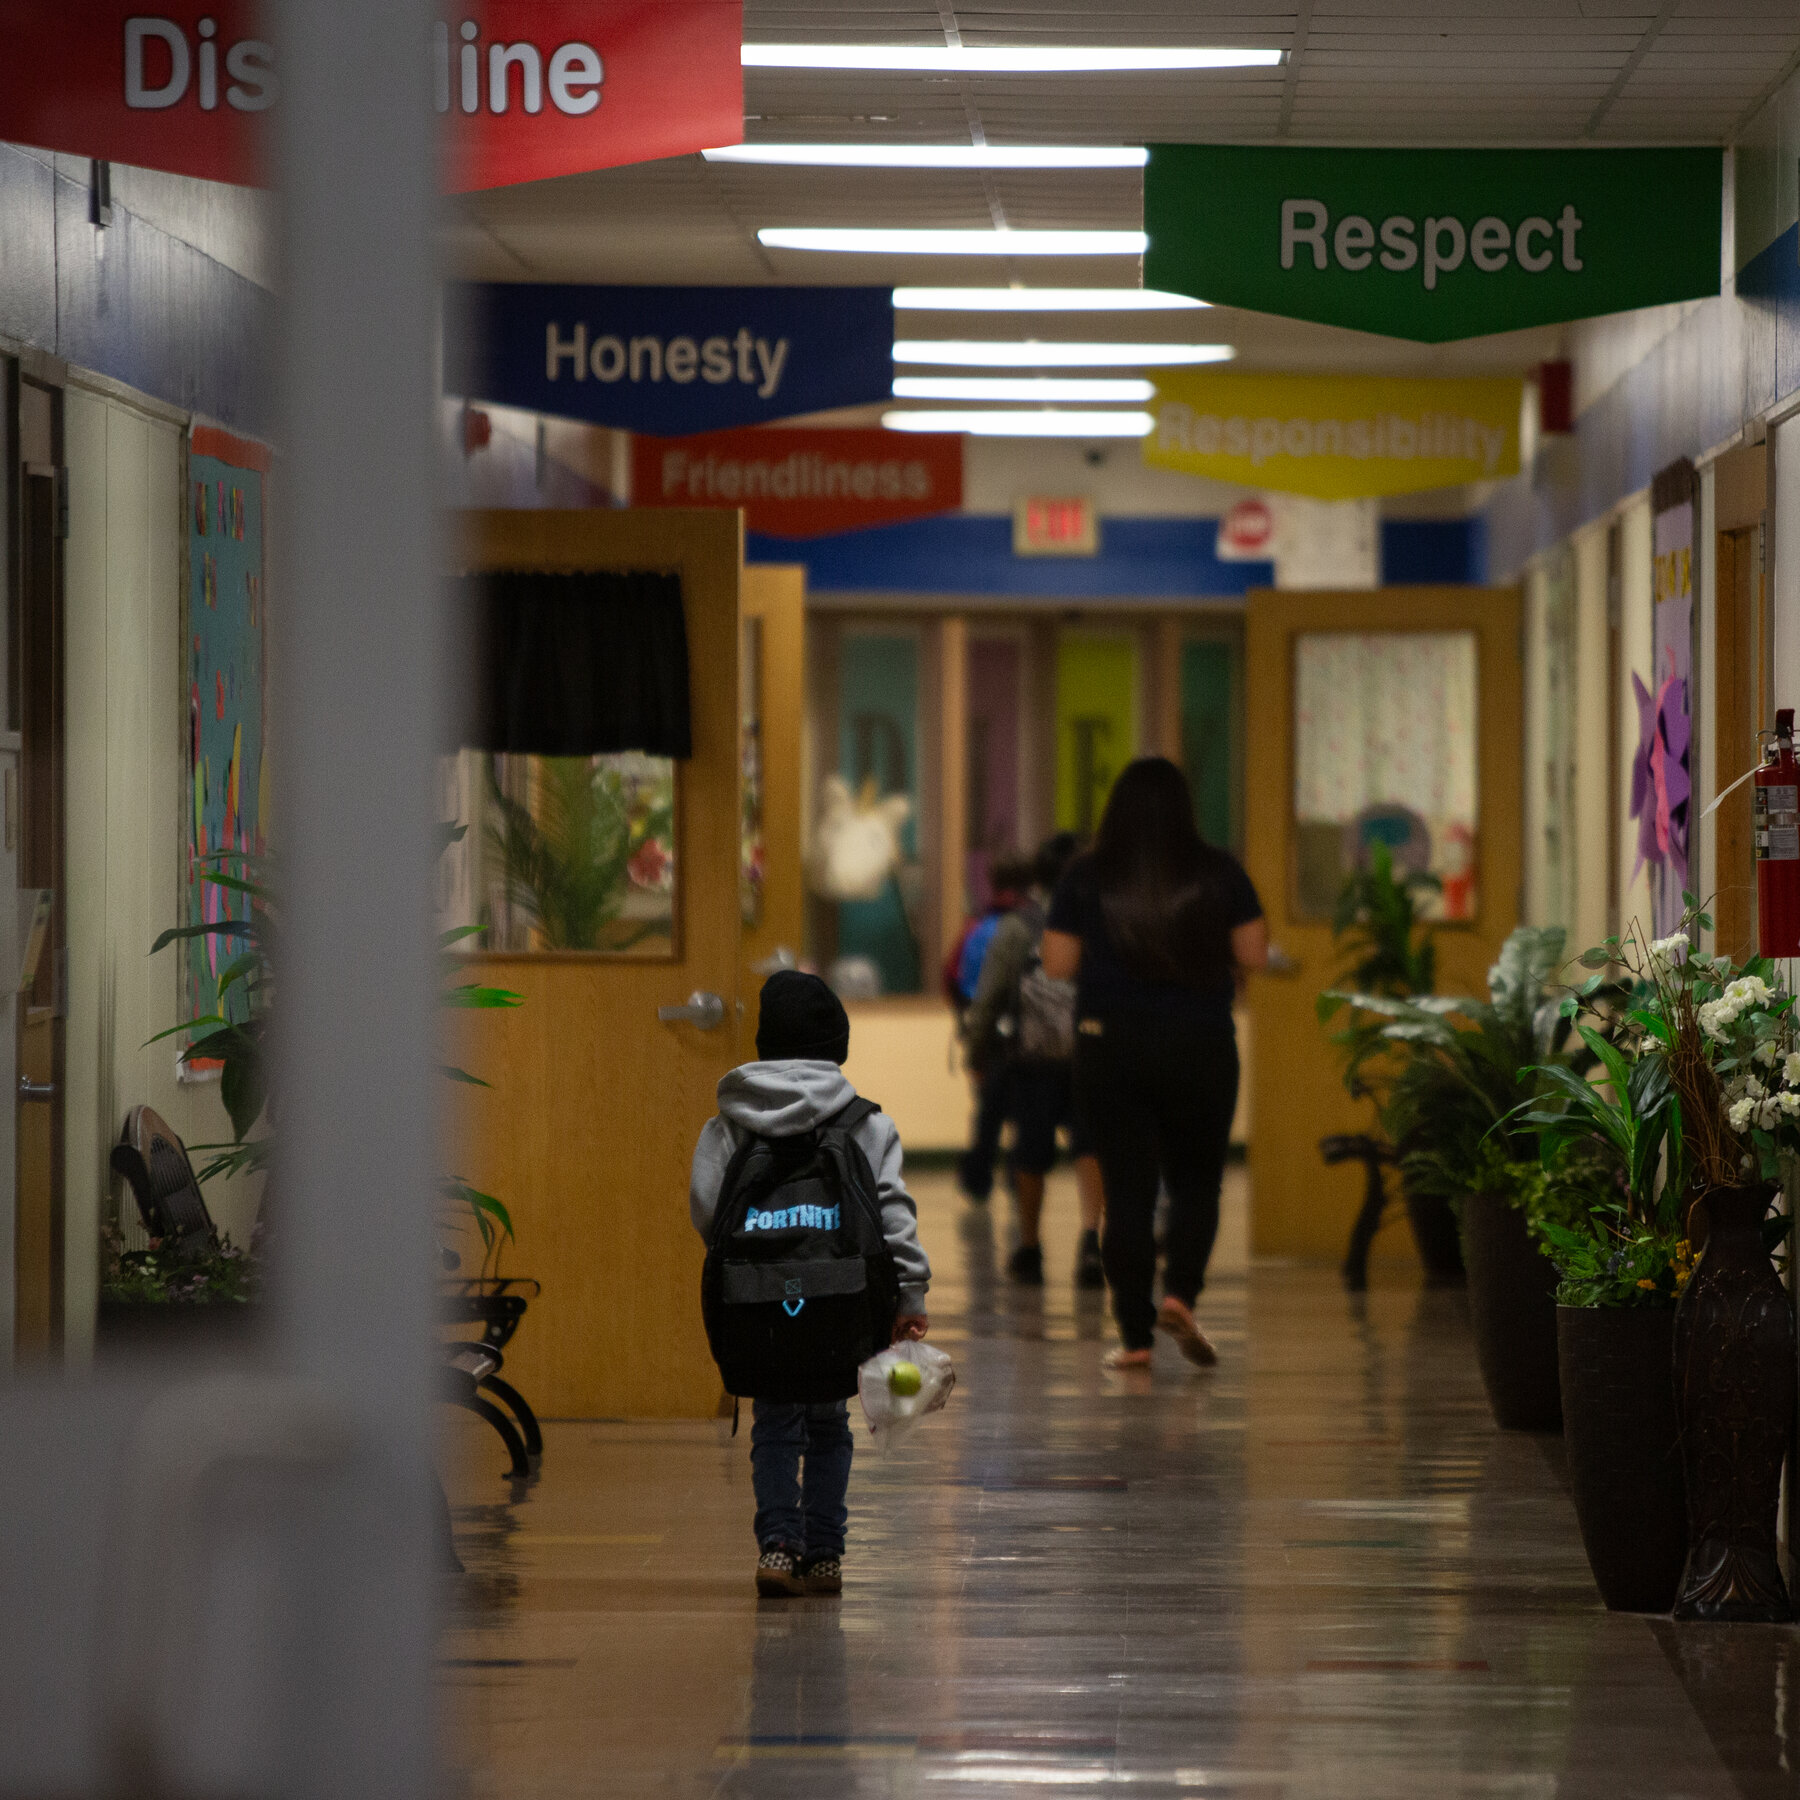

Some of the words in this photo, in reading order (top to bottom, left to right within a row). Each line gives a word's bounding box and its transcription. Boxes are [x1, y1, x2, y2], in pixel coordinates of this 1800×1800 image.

[123, 17, 604, 116] Disline
[1279, 198, 1584, 291] Respect
[545, 321, 788, 399] Honesty
[661, 450, 929, 499] Friendliness
[1155, 403, 1505, 468] Responsibility
